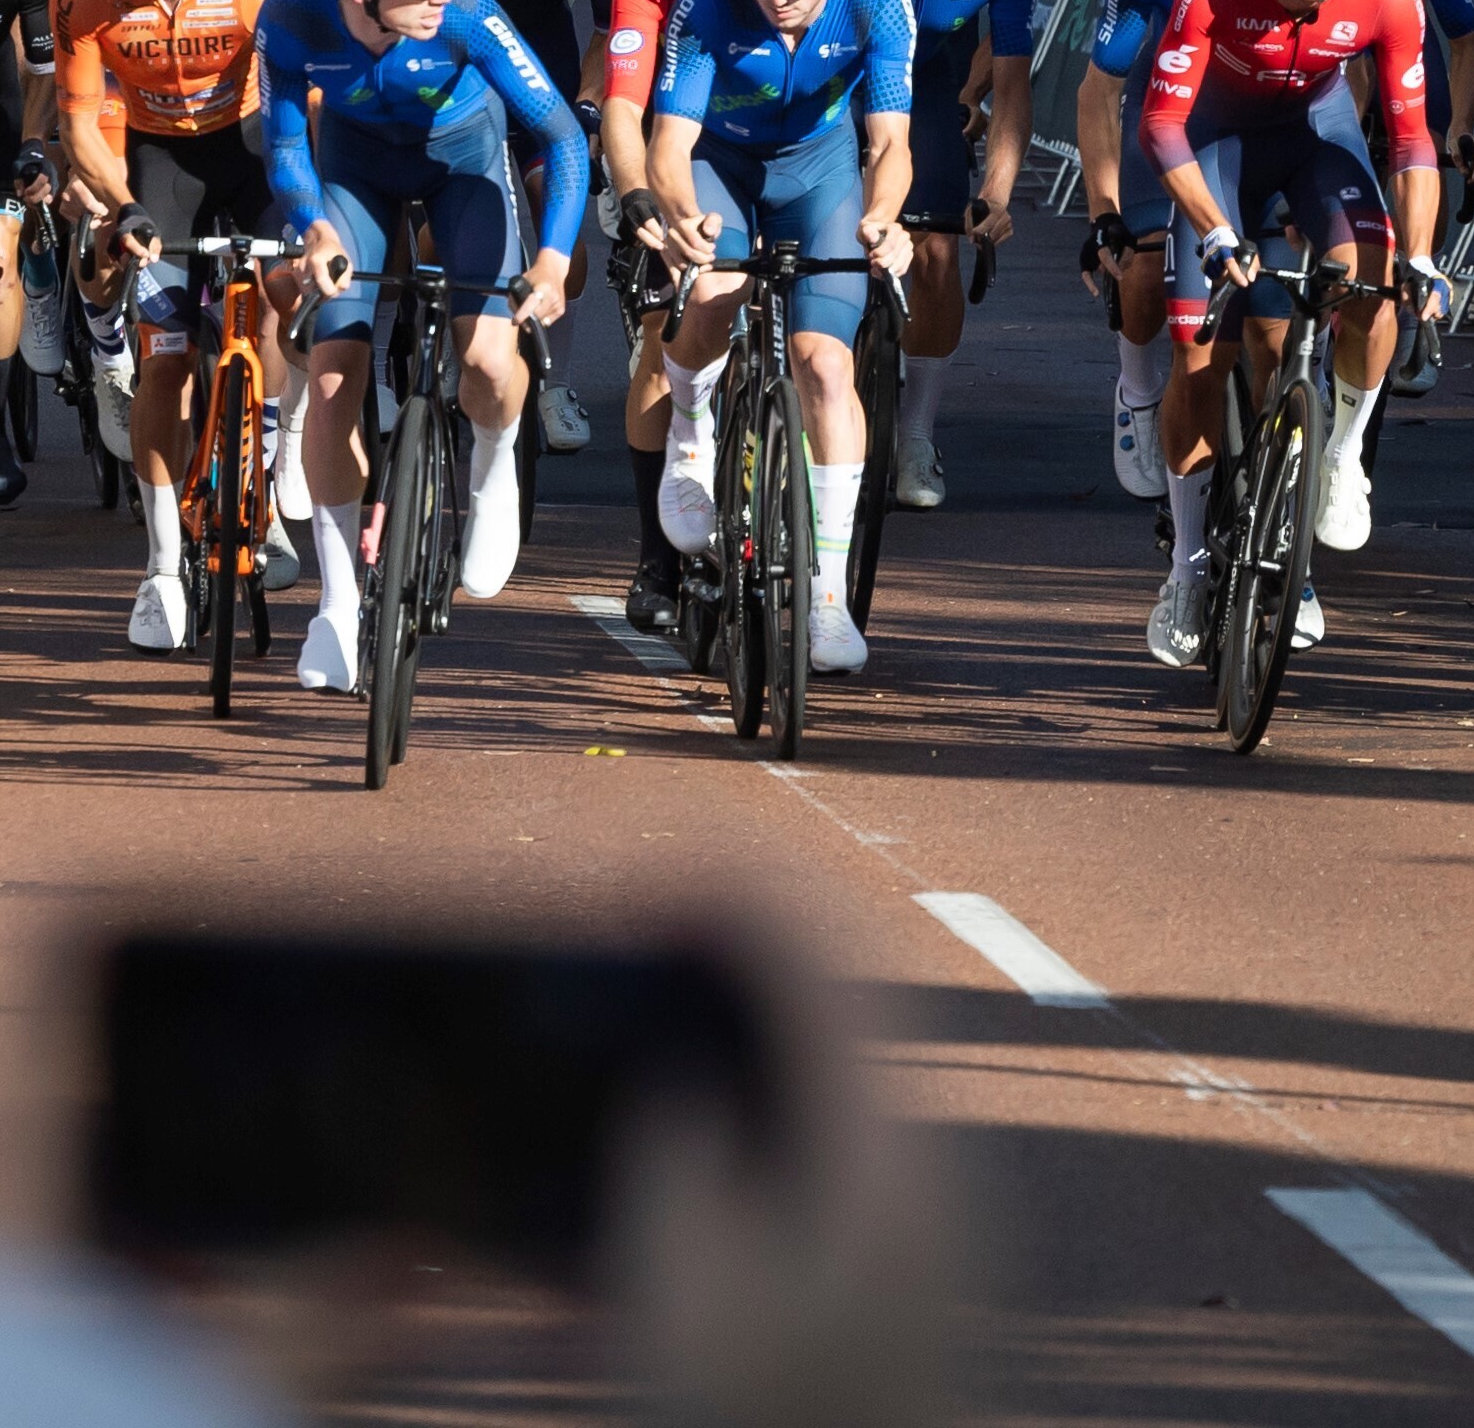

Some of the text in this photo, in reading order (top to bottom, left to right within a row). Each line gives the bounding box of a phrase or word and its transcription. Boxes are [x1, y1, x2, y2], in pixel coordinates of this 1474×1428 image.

[117, 34, 236, 60] VICTOIRE
[483, 15, 552, 93] GIANT
[610, 59, 639, 70] YRO
